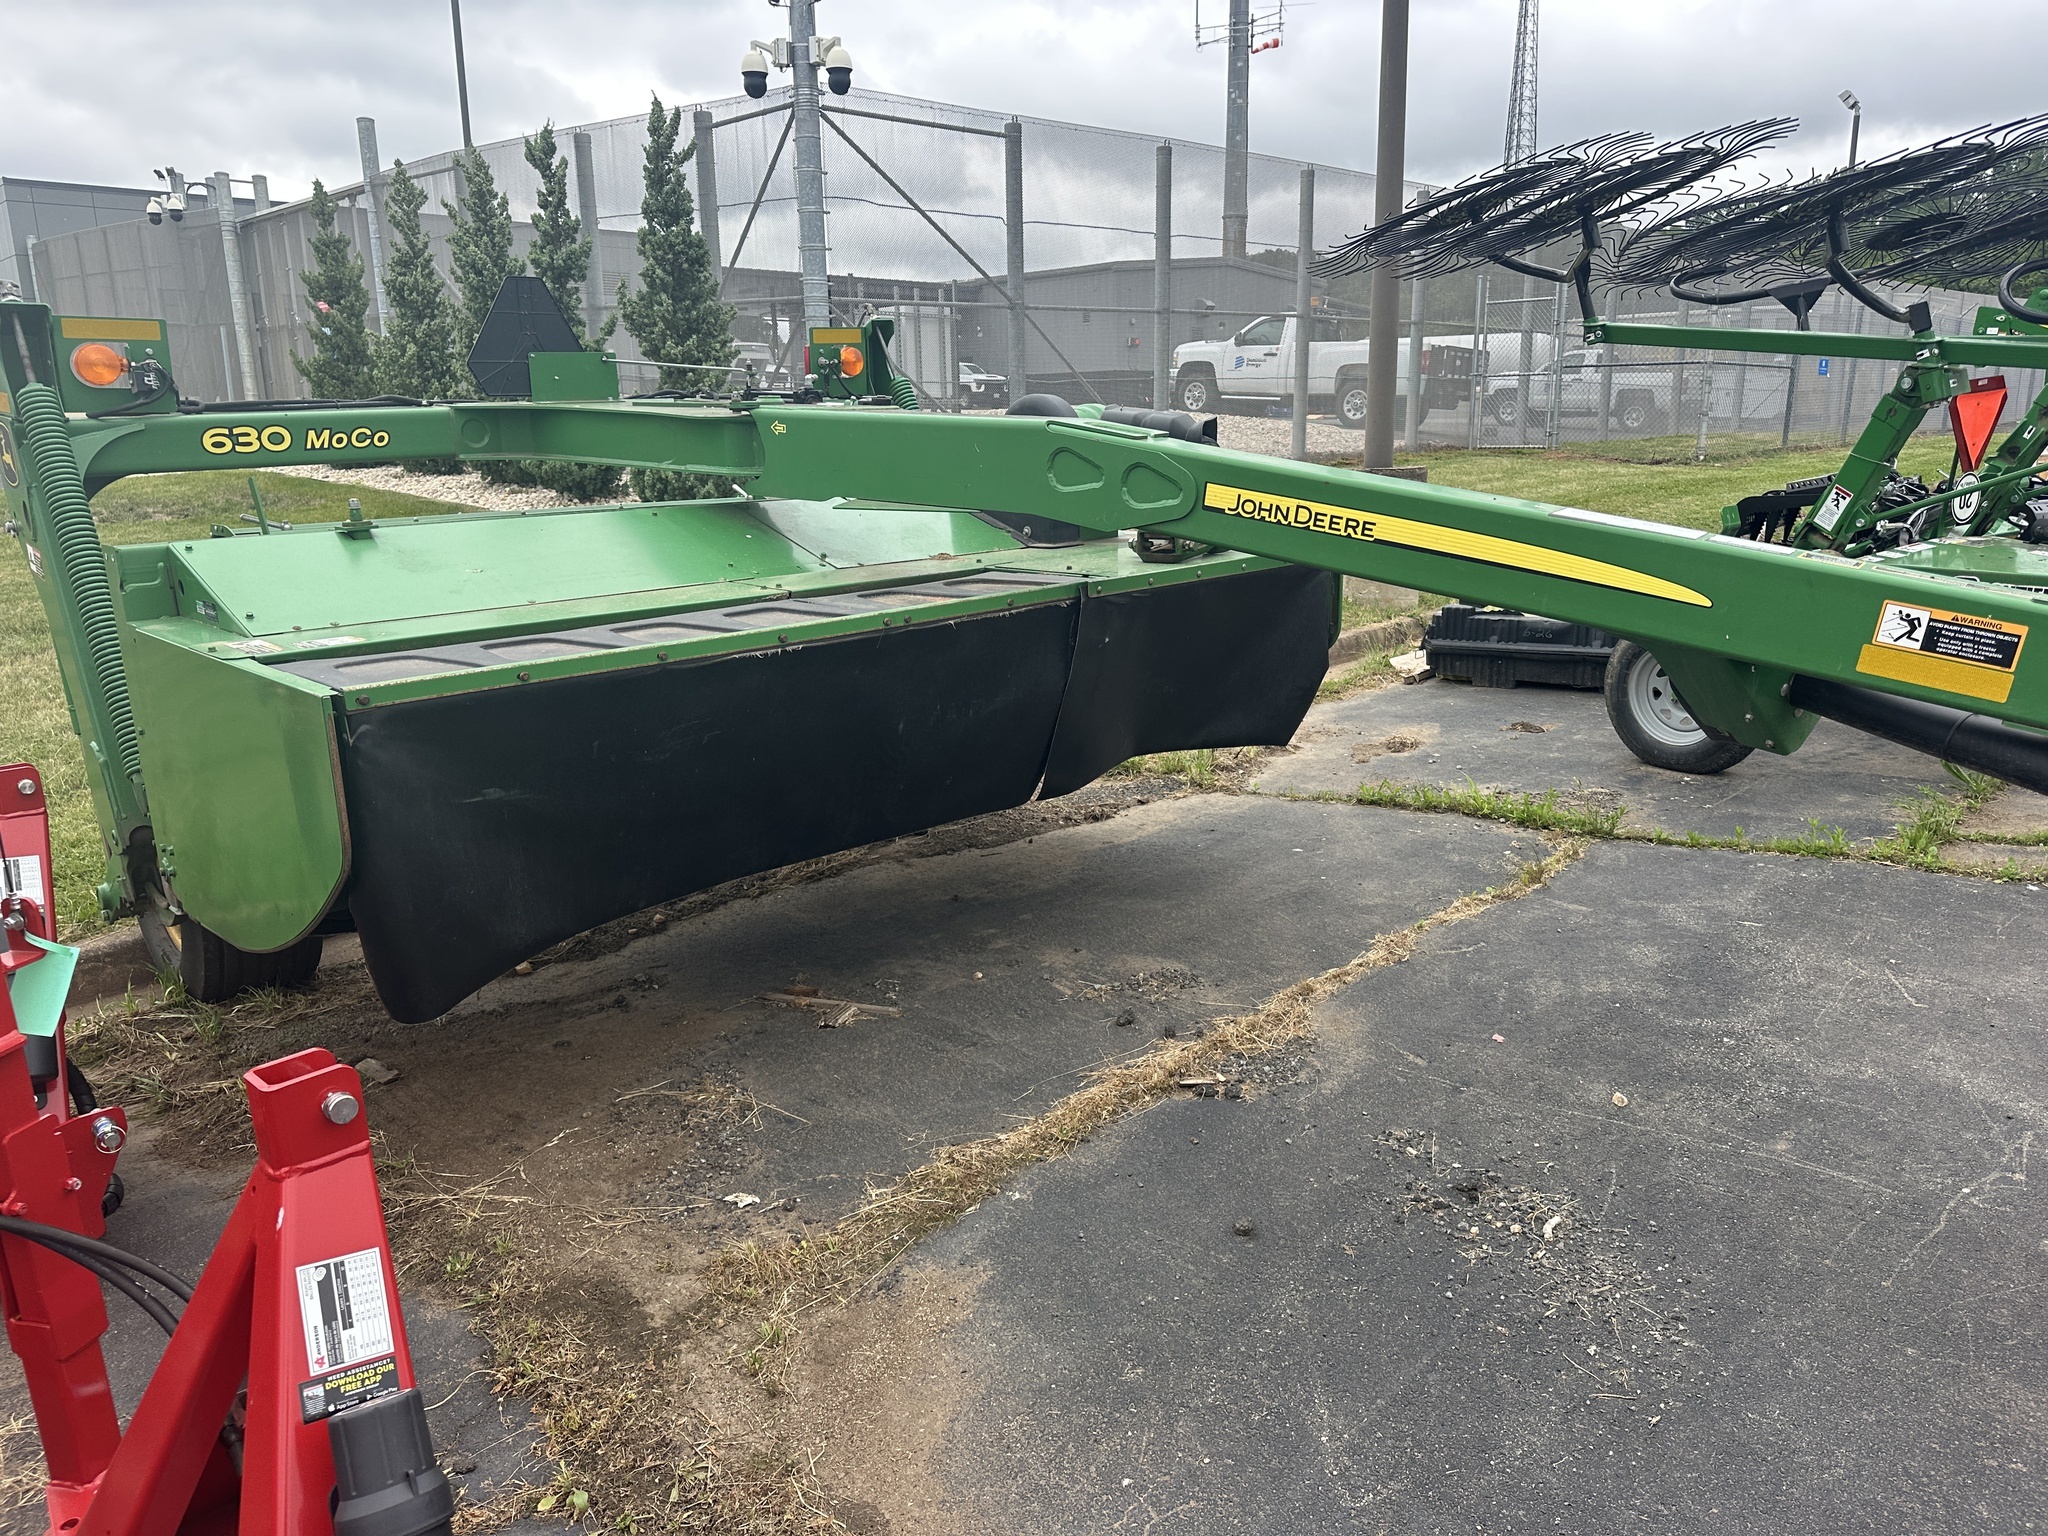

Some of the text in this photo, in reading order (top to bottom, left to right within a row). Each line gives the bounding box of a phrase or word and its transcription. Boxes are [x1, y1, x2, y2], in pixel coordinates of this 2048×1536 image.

[201, 425, 391, 454] 630 MoCo
[1227, 493, 1377, 538] JOHN DEERE
[1960, 616, 2003, 630] WARNING
[1944, 624, 1960, 632] INJURY
[1975, 630, 1996, 638] THROWN
[1996, 634, 2019, 643] OBJECTS
[1955, 632, 1974, 641] curtain
[1936, 647, 1986, 660] operator enclosure.
[1937, 642, 1961, 651] equipped
[1978, 650, 2003, 659] complete
[313, 1324, 321, 1356] ANDERSON
[325, 1363, 395, 1390] DOWNLOAD OUR
[327, 1359, 391, 1381] NEED ASSISTANCE?
[340, 1381, 363, 1393] FREE
[364, 1374, 382, 1386] APP
[373, 1389, 388, 1397] Google
